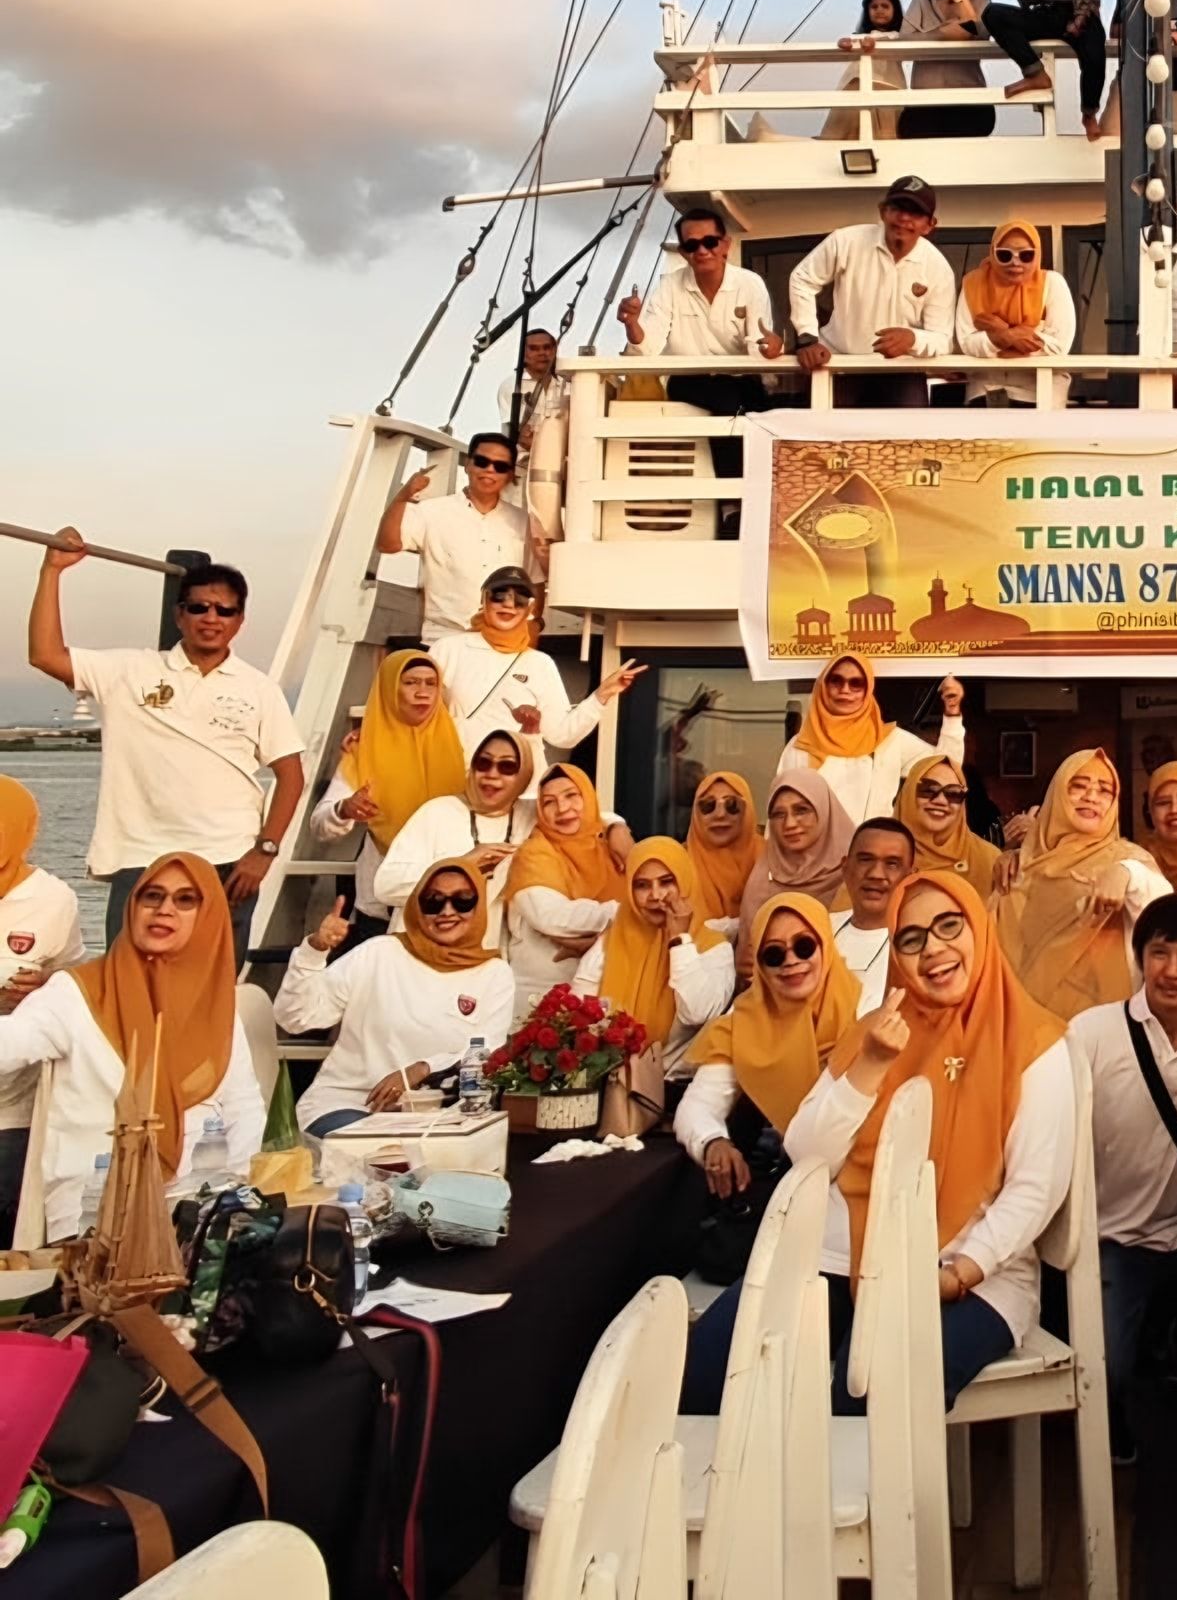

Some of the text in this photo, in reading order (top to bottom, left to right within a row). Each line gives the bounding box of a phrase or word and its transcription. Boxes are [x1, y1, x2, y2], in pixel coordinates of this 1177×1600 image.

[1006, 475, 1143, 500] HALAL
[1016, 526, 1144, 549] TEMU
[998, 563, 1125, 603] SMANSA
